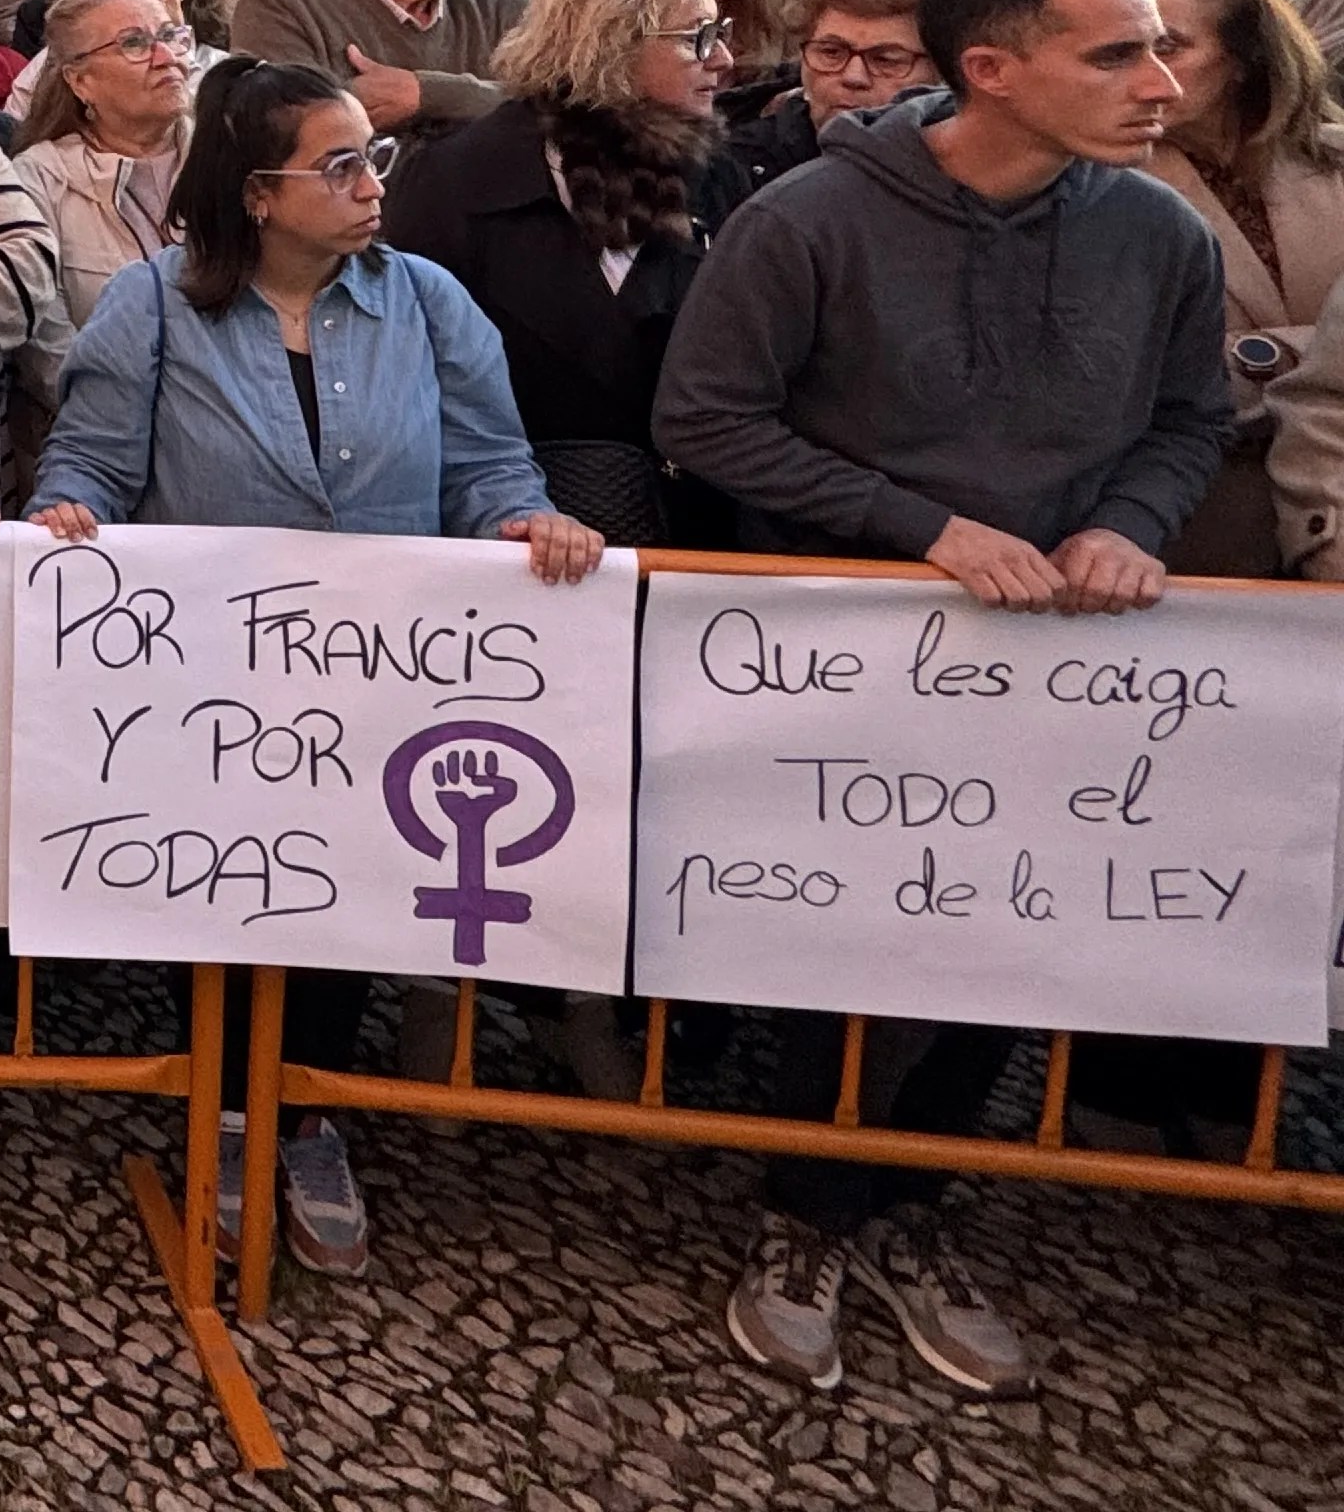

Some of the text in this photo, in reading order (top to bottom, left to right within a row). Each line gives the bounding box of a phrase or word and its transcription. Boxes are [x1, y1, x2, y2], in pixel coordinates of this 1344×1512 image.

[28, 544, 186, 670] POR
[699, 607, 1238, 743] Que les caiga
[93, 699, 354, 788] Y POR
[773, 754, 1153, 828] TODO el
[39, 813, 338, 927] TODAS
[665, 847, 1247, 936] peso de la LEY
